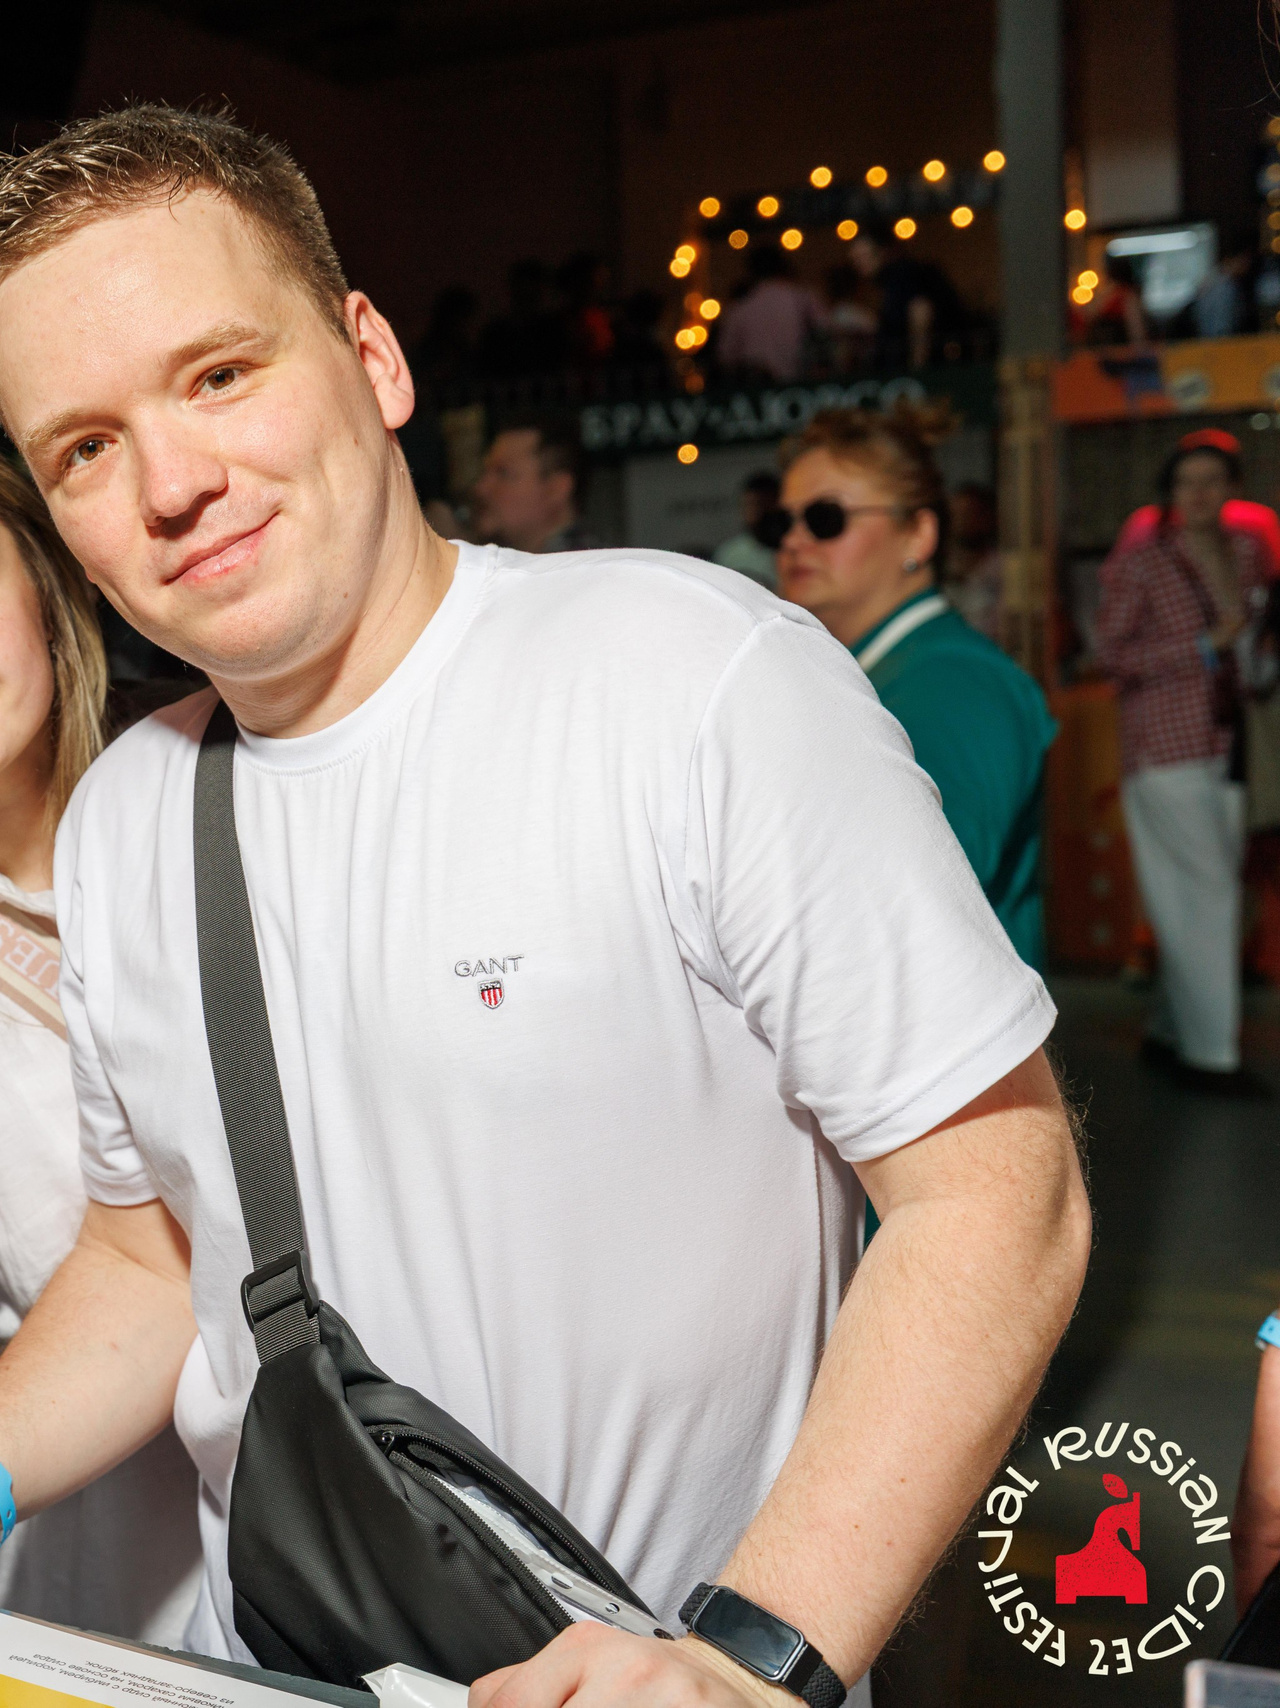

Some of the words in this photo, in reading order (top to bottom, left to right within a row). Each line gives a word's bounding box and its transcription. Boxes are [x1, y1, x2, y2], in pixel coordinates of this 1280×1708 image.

[455, 954, 524, 977] GANT
[8, 1654, 56, 1670] корицей
[32, 1653, 66, 1666] сидра
[84, 1660, 119, 1673] яблок.
[67, 1663, 108, 1678] основе
[121, 1670, 217, 1700] северо-западных
[121, 1687, 150, 1698] сидр
[127, 1679, 175, 1697] сахаром,
